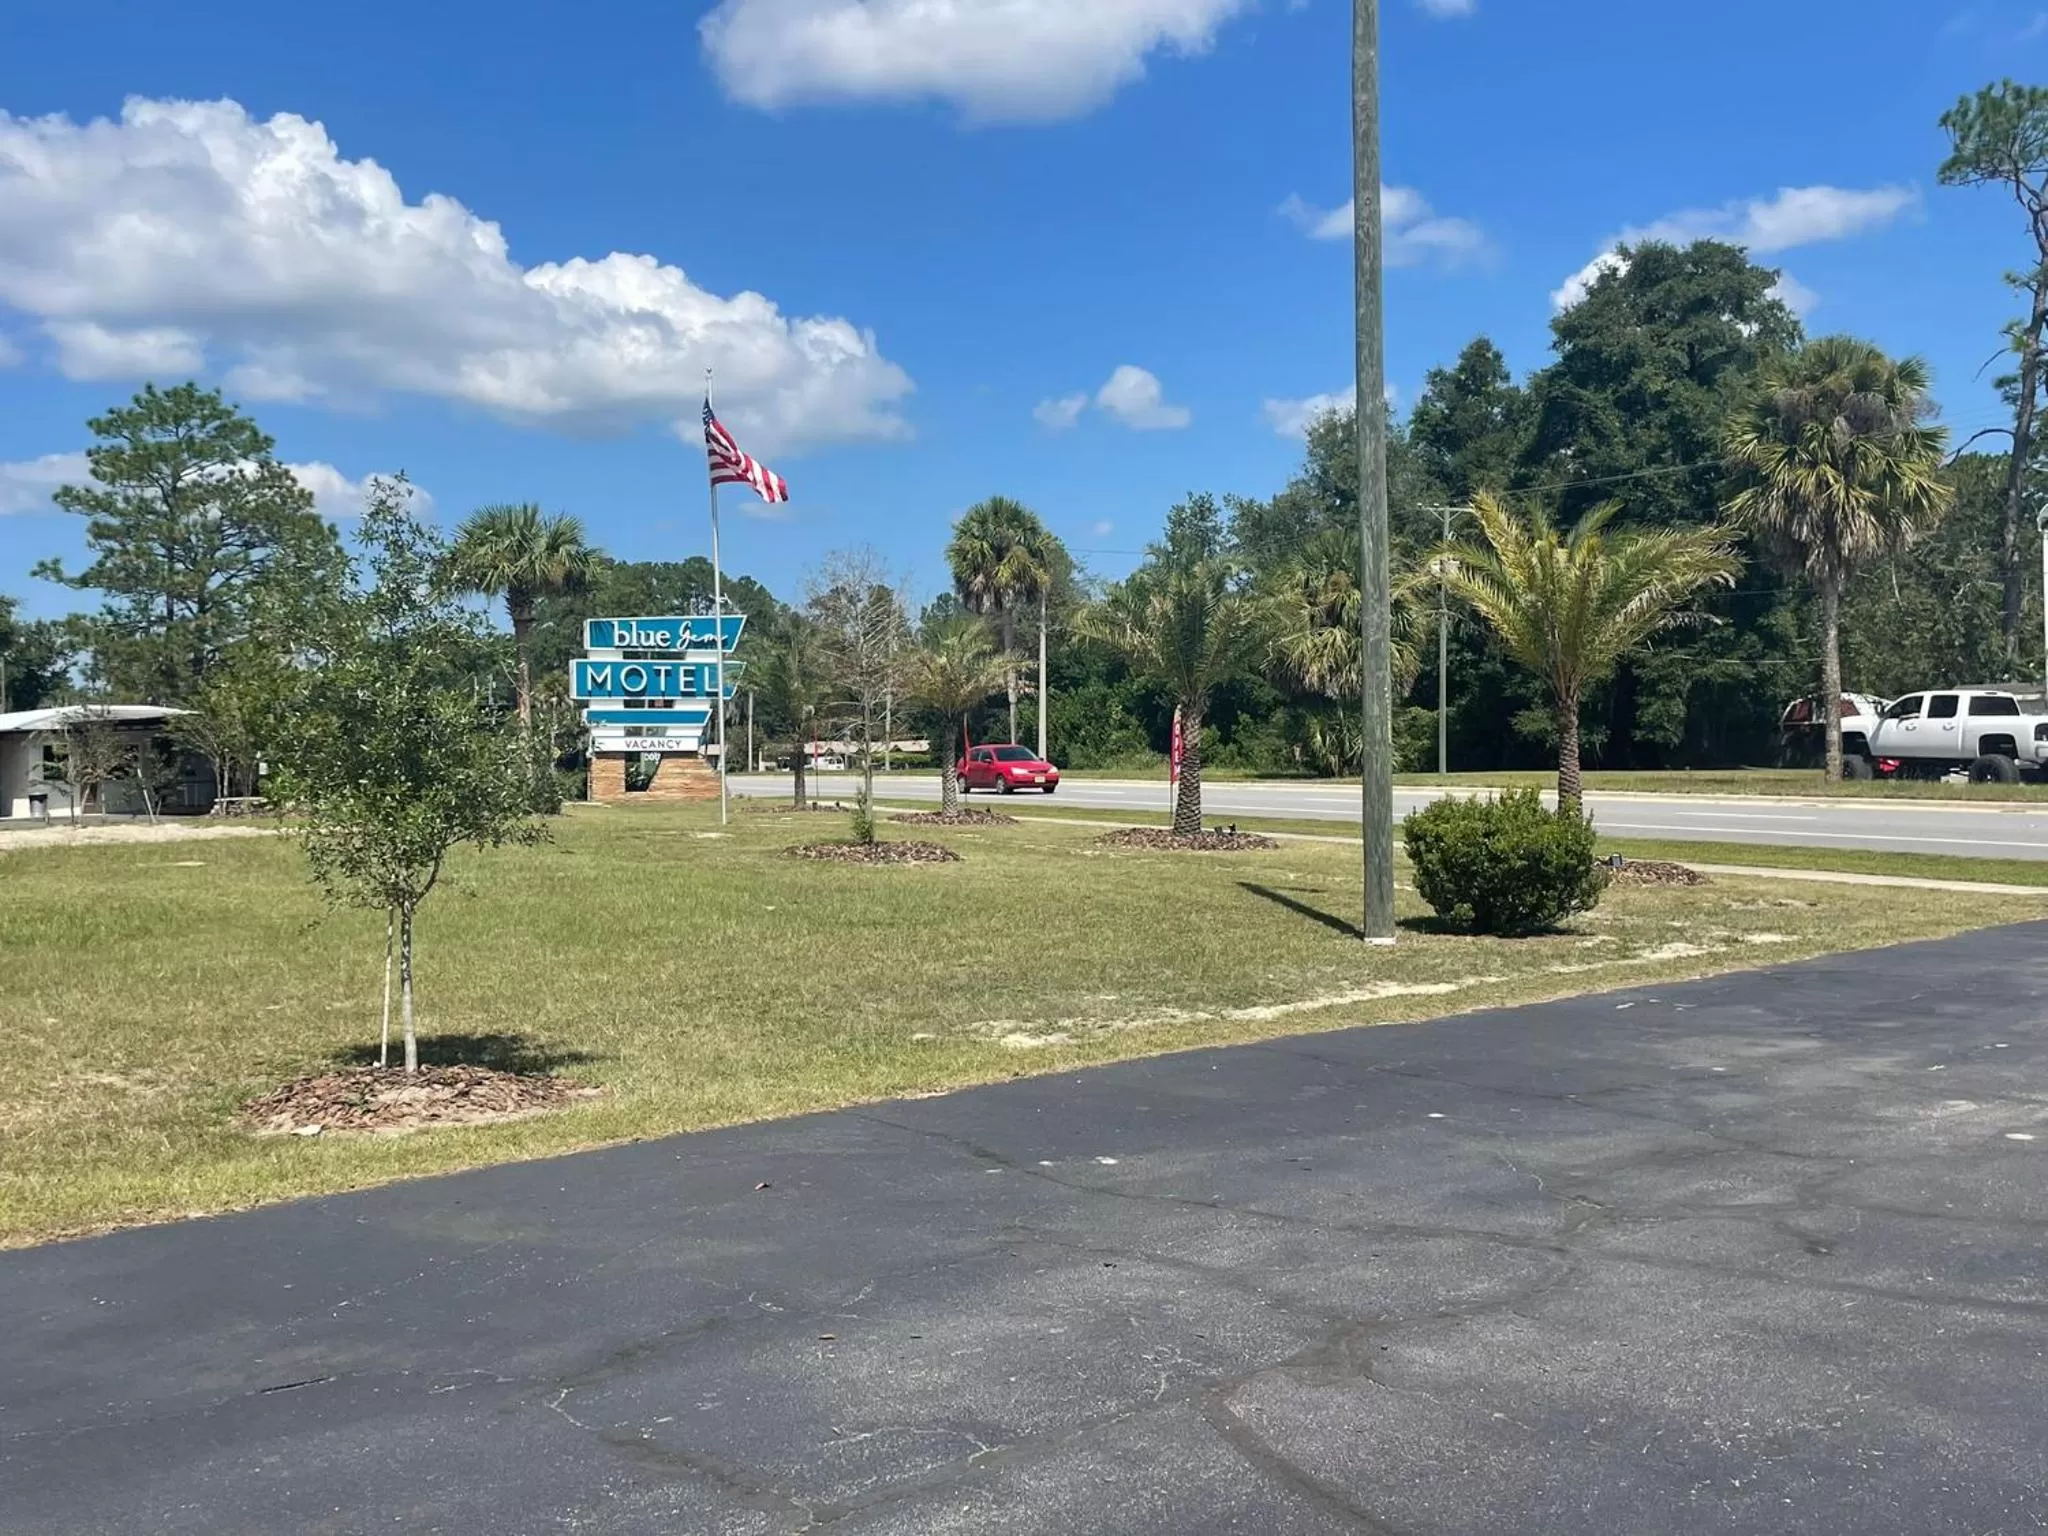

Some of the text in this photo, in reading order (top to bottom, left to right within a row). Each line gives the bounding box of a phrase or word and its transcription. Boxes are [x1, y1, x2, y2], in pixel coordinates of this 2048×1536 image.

[613, 621, 672, 647] blue
[586, 664, 720, 692] MOTEL
[624, 739, 683, 749] VACANCY
